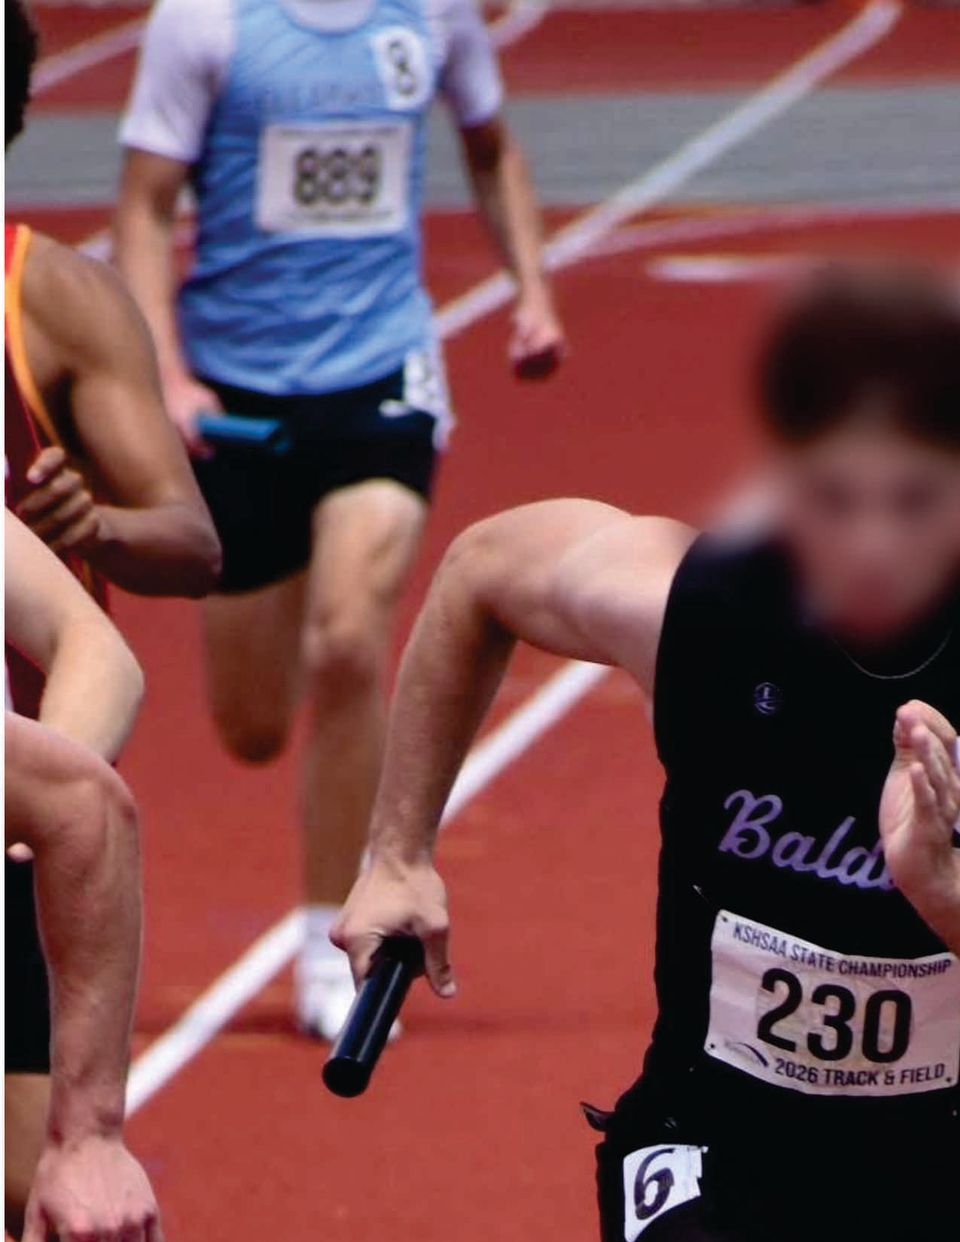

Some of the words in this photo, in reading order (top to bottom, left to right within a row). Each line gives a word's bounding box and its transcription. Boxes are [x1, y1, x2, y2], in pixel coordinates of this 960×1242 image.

[293, 146, 383, 207] 889
[732, 921, 788, 957] KSHSAA
[790, 944, 835, 972] STATE
[838, 957, 952, 979] CHAMPIONSHIP
[756, 967, 912, 1063] 230
[774, 1057, 819, 1084] 2026
[823, 1068, 879, 1087] TRACK
[884, 1069, 895, 1086] &
[900, 1063, 946, 1084] FIELD
[633, 1147, 676, 1221] 6
